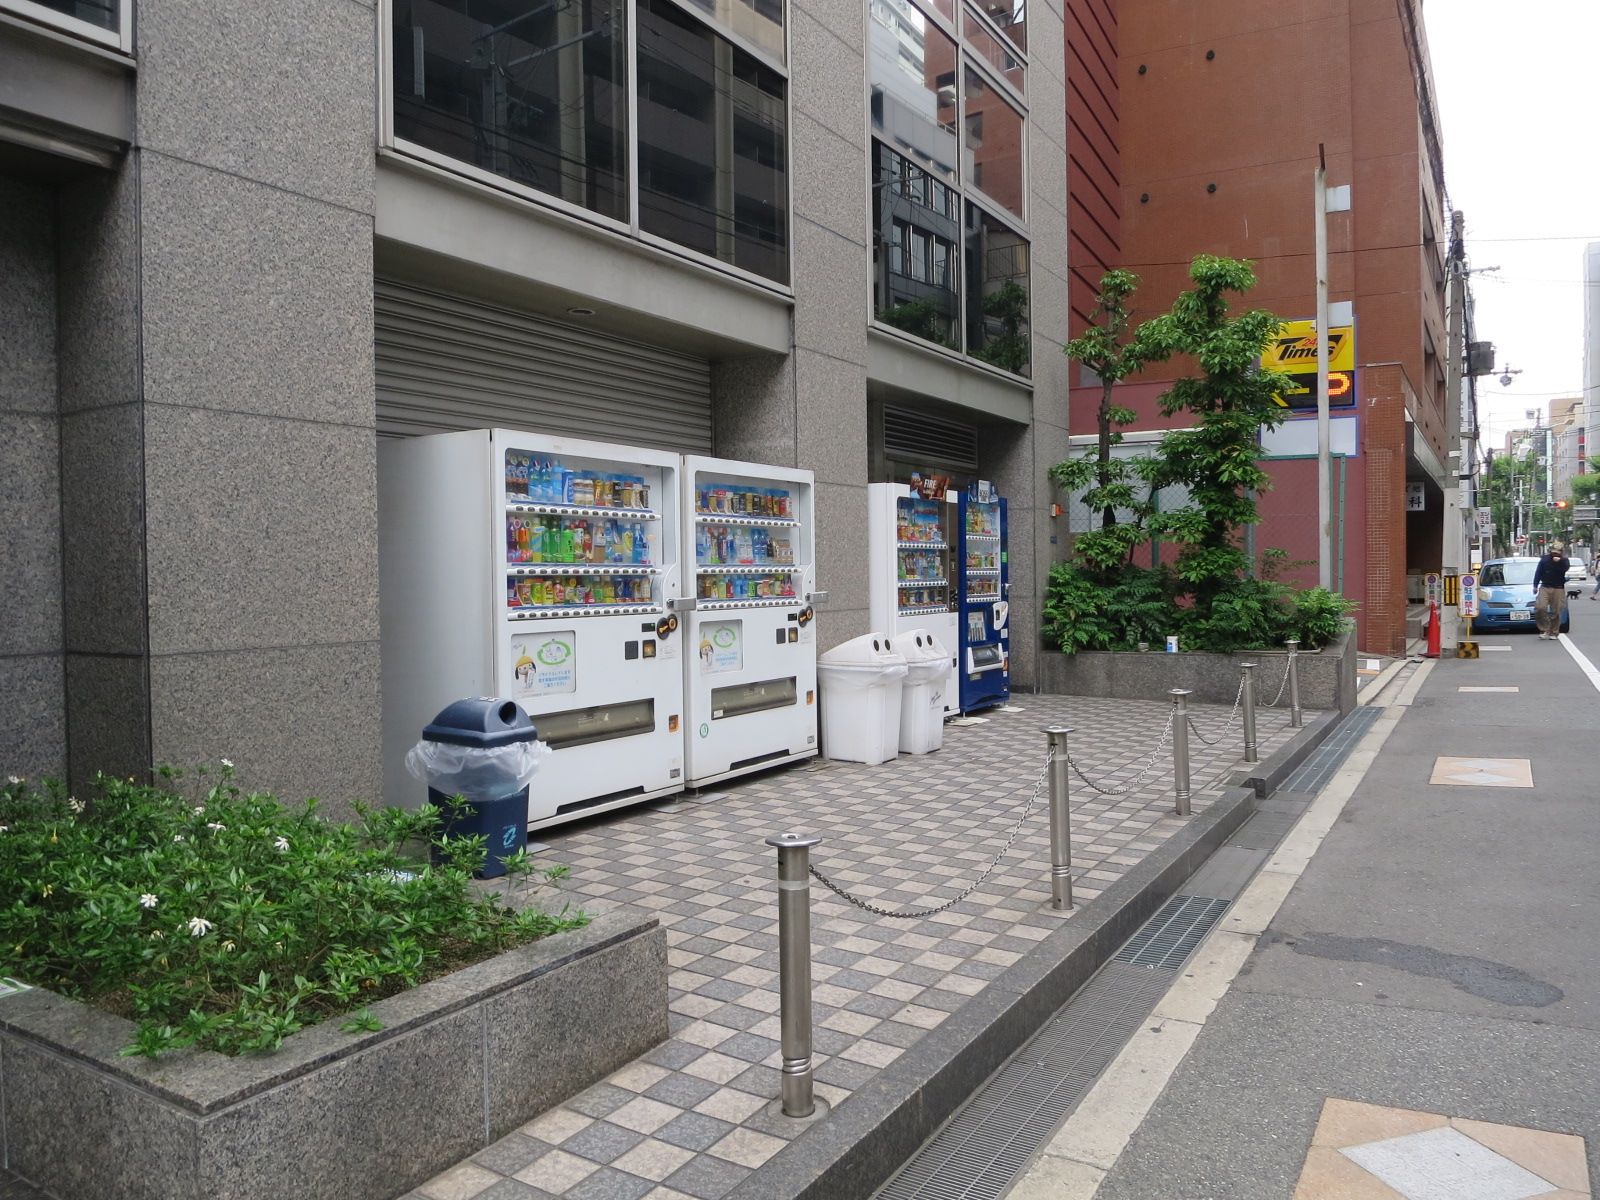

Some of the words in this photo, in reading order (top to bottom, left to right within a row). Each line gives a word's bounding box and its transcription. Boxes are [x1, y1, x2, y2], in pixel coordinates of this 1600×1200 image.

[923, 479, 937, 489] FIRE
[1464, 587, 1472, 615] 駐車禁止
